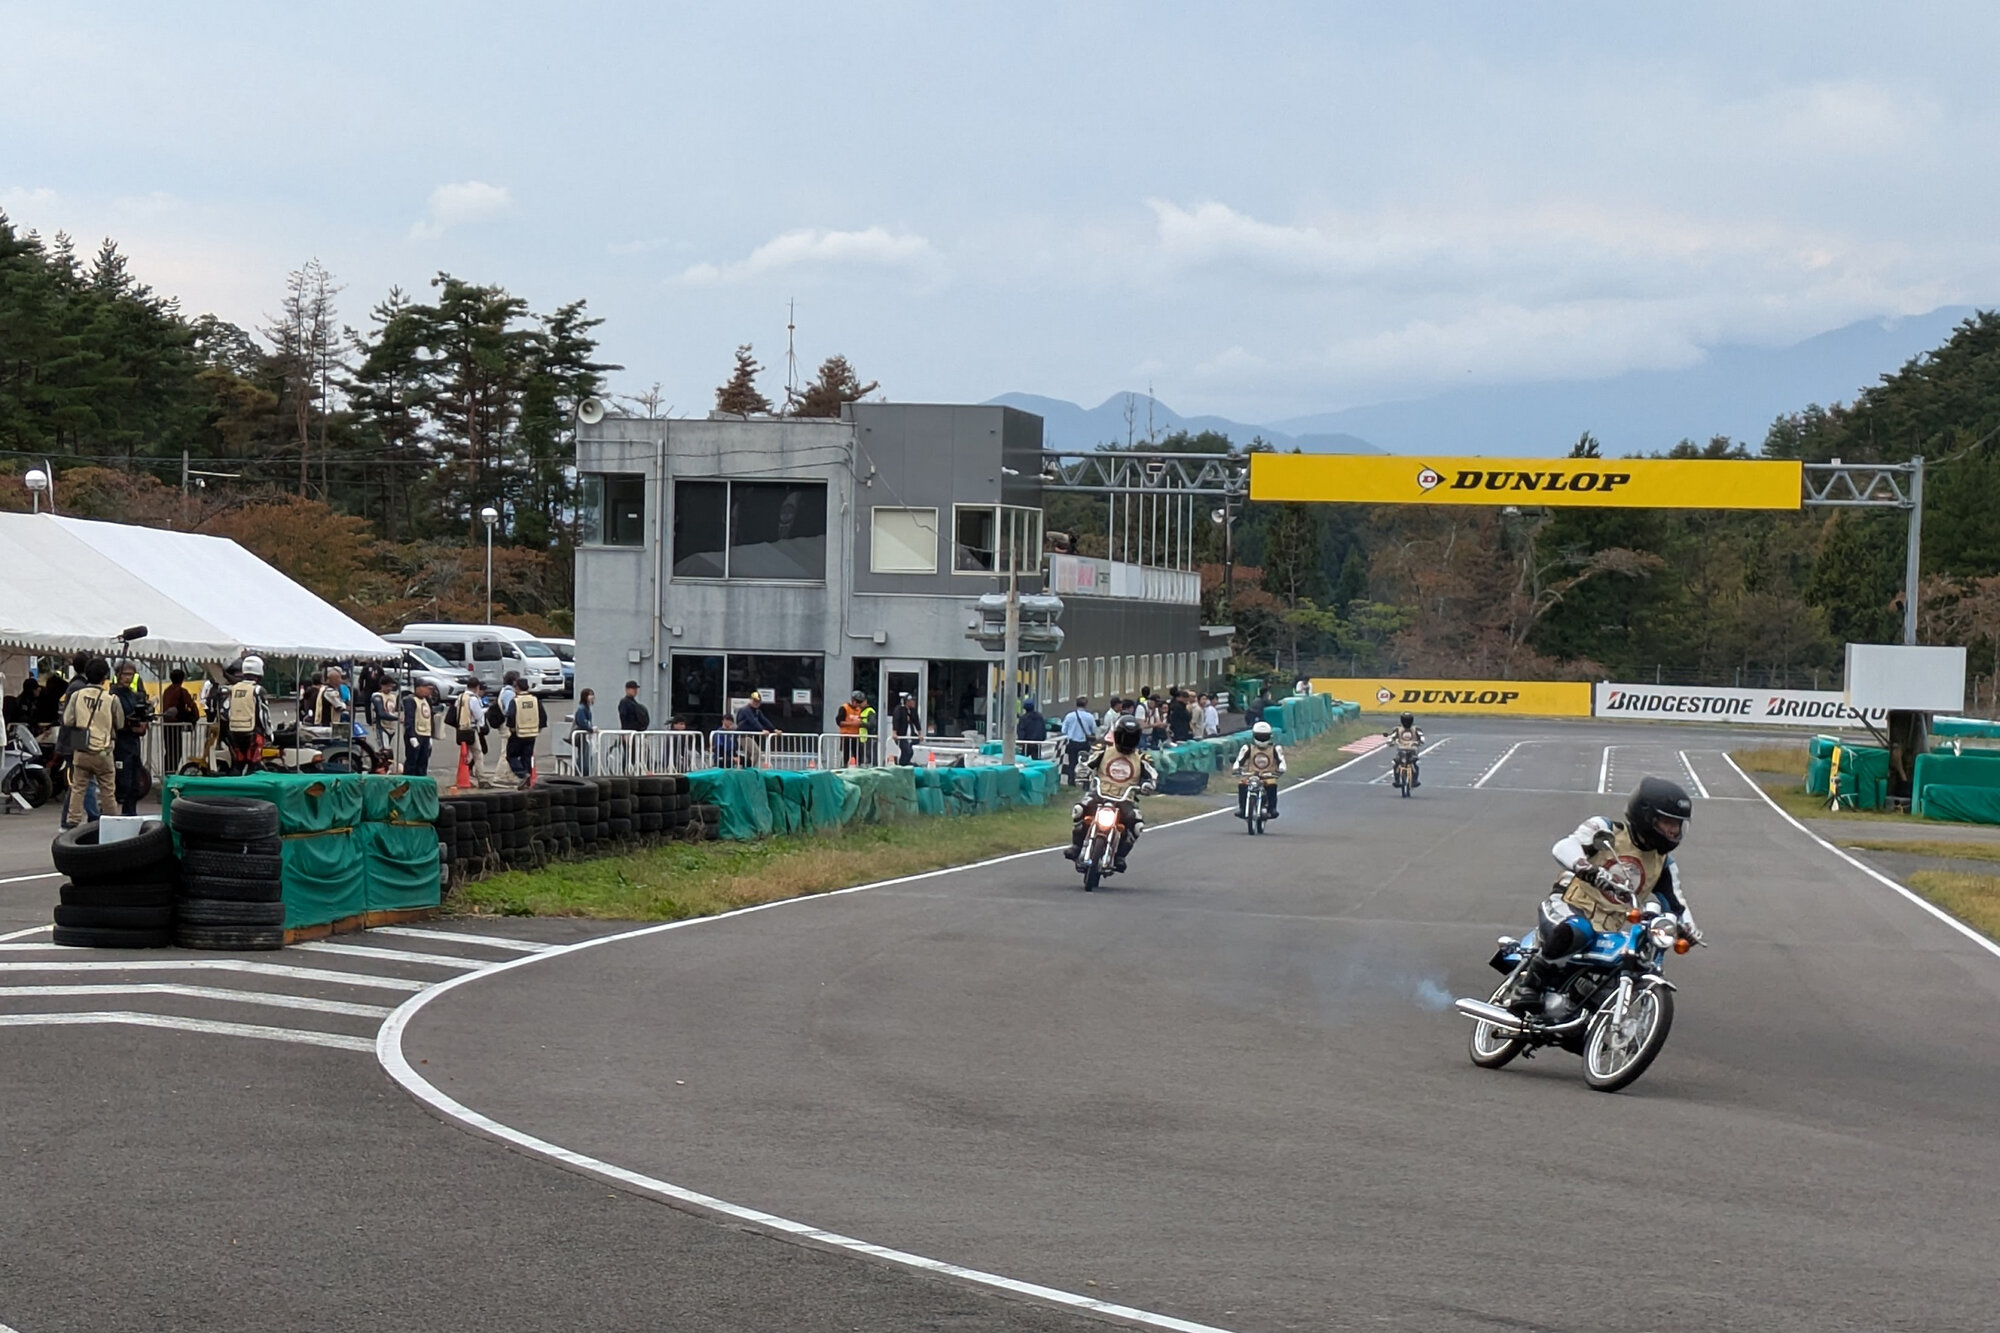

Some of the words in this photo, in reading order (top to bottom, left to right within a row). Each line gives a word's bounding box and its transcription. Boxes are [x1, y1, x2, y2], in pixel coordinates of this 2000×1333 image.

[1450, 471, 1631, 492] DUNLOP
[1399, 690, 1520, 705] DUNLOP
[1606, 691, 1754, 715] BRIDGESTONE
[1765, 697, 1888, 721] BRIDGESTO
